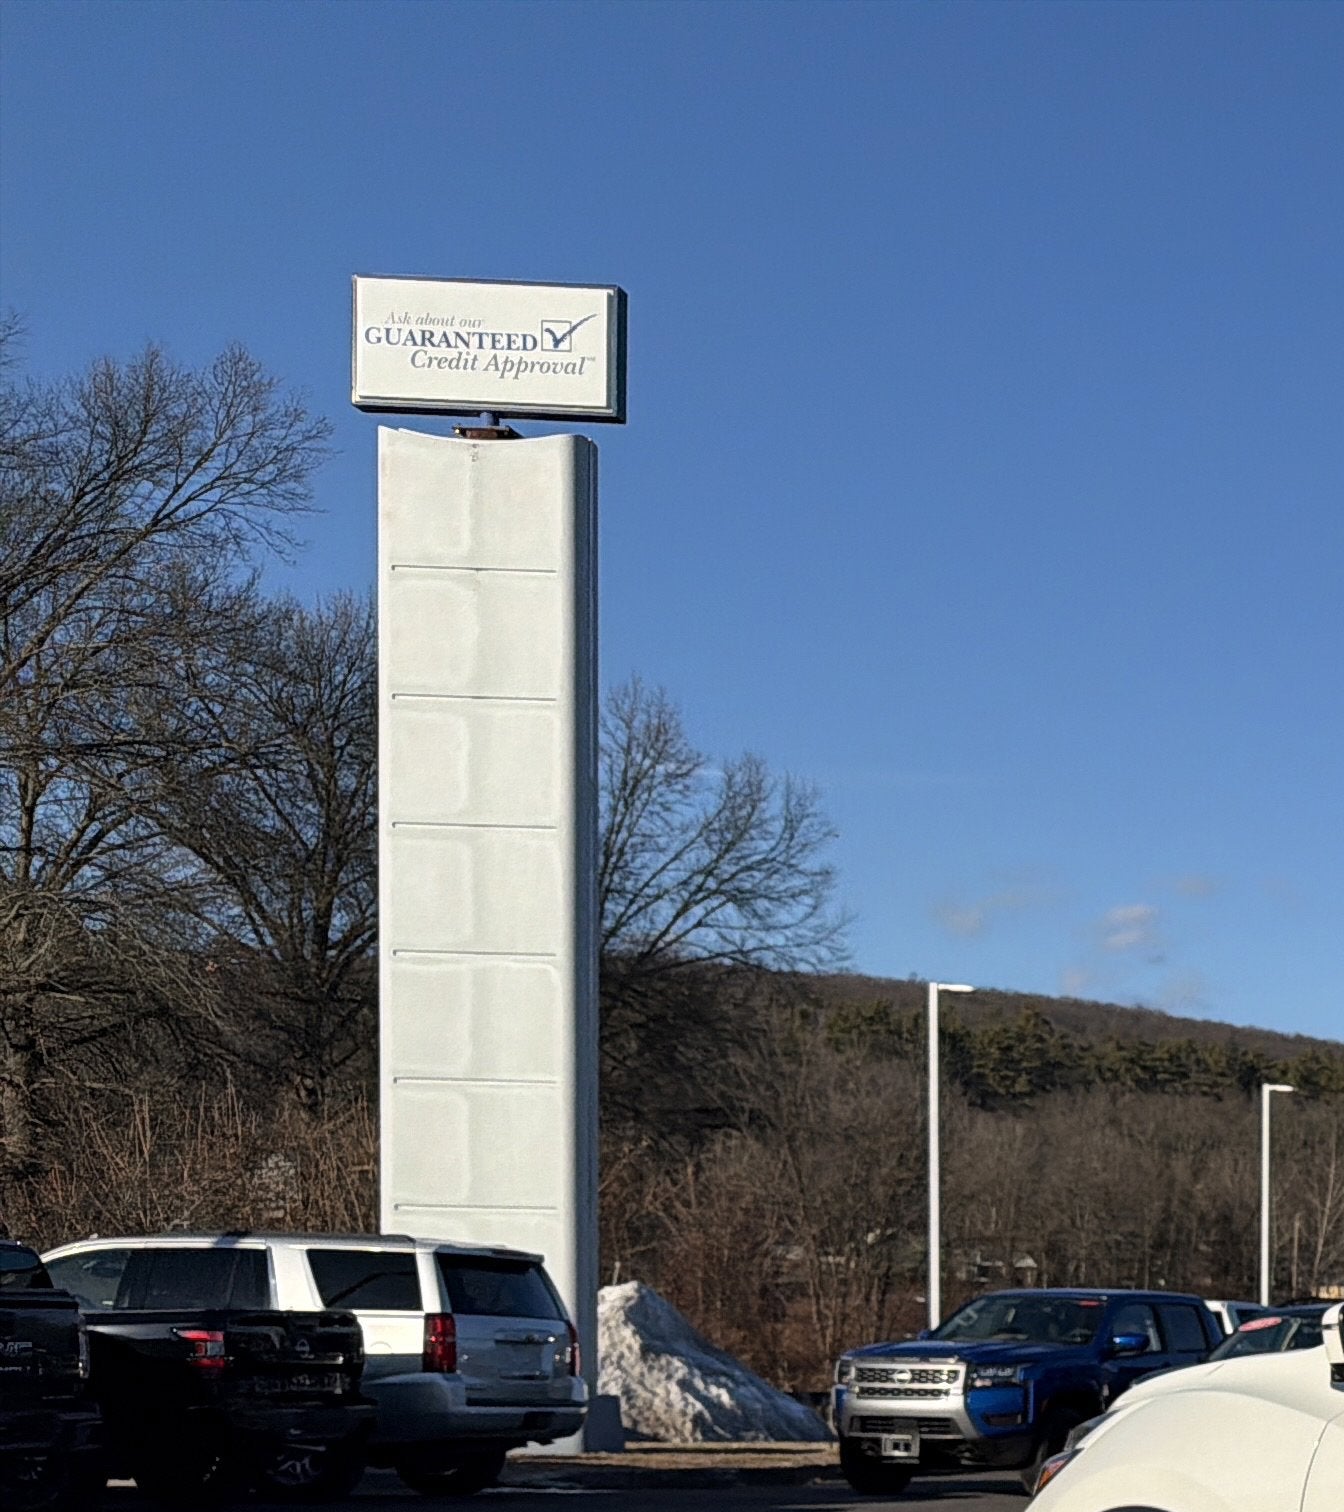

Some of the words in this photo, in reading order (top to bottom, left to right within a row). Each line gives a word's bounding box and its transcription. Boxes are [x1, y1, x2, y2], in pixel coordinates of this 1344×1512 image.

[384, 311, 411, 325] Ask
[415, 312, 455, 327] about
[459, 318, 482, 328] our
[364, 326, 538, 351] GUARANTEED
[410, 349, 478, 370] Credit
